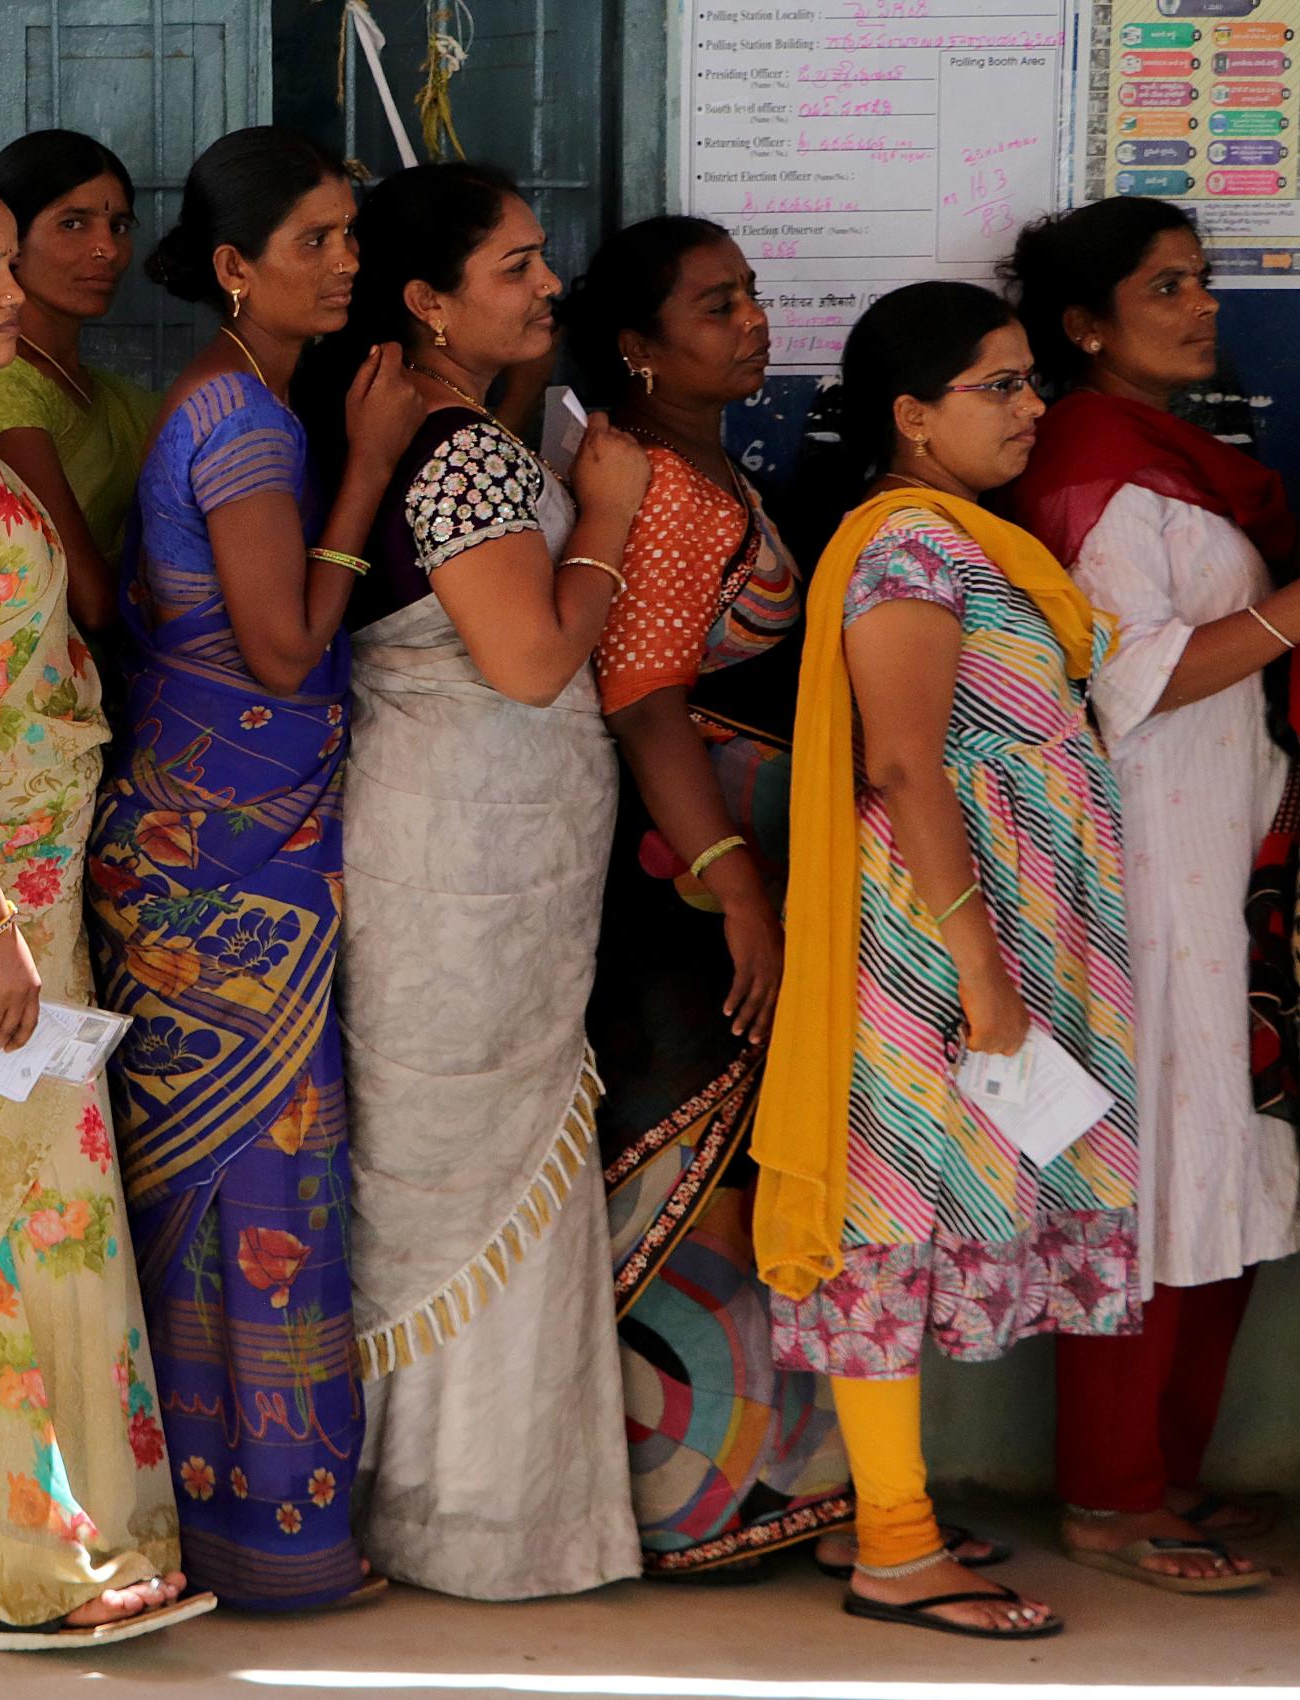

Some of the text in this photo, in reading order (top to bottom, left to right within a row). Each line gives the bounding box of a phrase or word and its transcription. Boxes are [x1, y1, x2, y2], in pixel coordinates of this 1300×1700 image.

[706, 10, 738, 23] Polling
[741, 9, 772, 21] Station
[705, 40, 737, 52] Polling
[740, 39, 772, 50] Station
[775, 37, 814, 51] Building
[950, 56, 1046, 69] Polling Booth Area
[705, 69, 748, 82] Presiding
[751, 67, 783, 79] Officer
[705, 103, 731, 115] Booth
[733, 103, 755, 114] level
[704, 137, 750, 149] Returning
[753, 135, 785, 147] Officer
[704, 172, 738, 182] District
[740, 171, 778, 182] Election
[779, 171, 812, 181] Officer
[742, 225, 778, 237] Election
[781, 224, 823, 235] Observer
